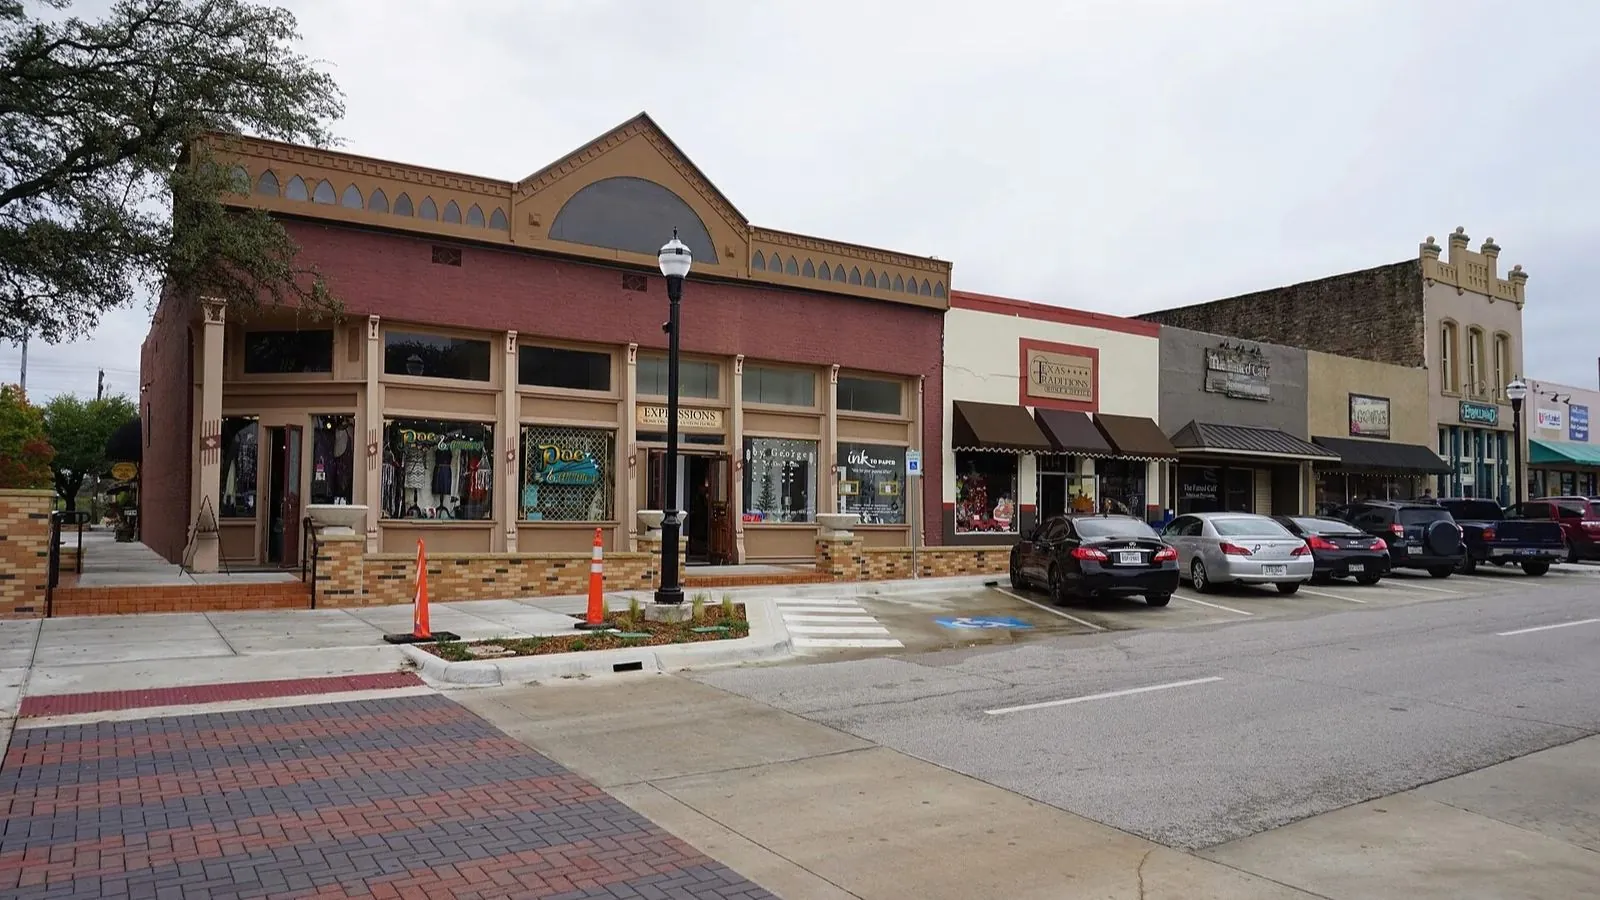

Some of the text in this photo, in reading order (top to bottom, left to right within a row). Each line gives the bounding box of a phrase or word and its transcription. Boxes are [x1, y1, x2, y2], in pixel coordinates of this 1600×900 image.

[643, 407, 716, 420] EXPSSIONS
[771, 448, 808, 461] George
[847, 449, 875, 468] ink
